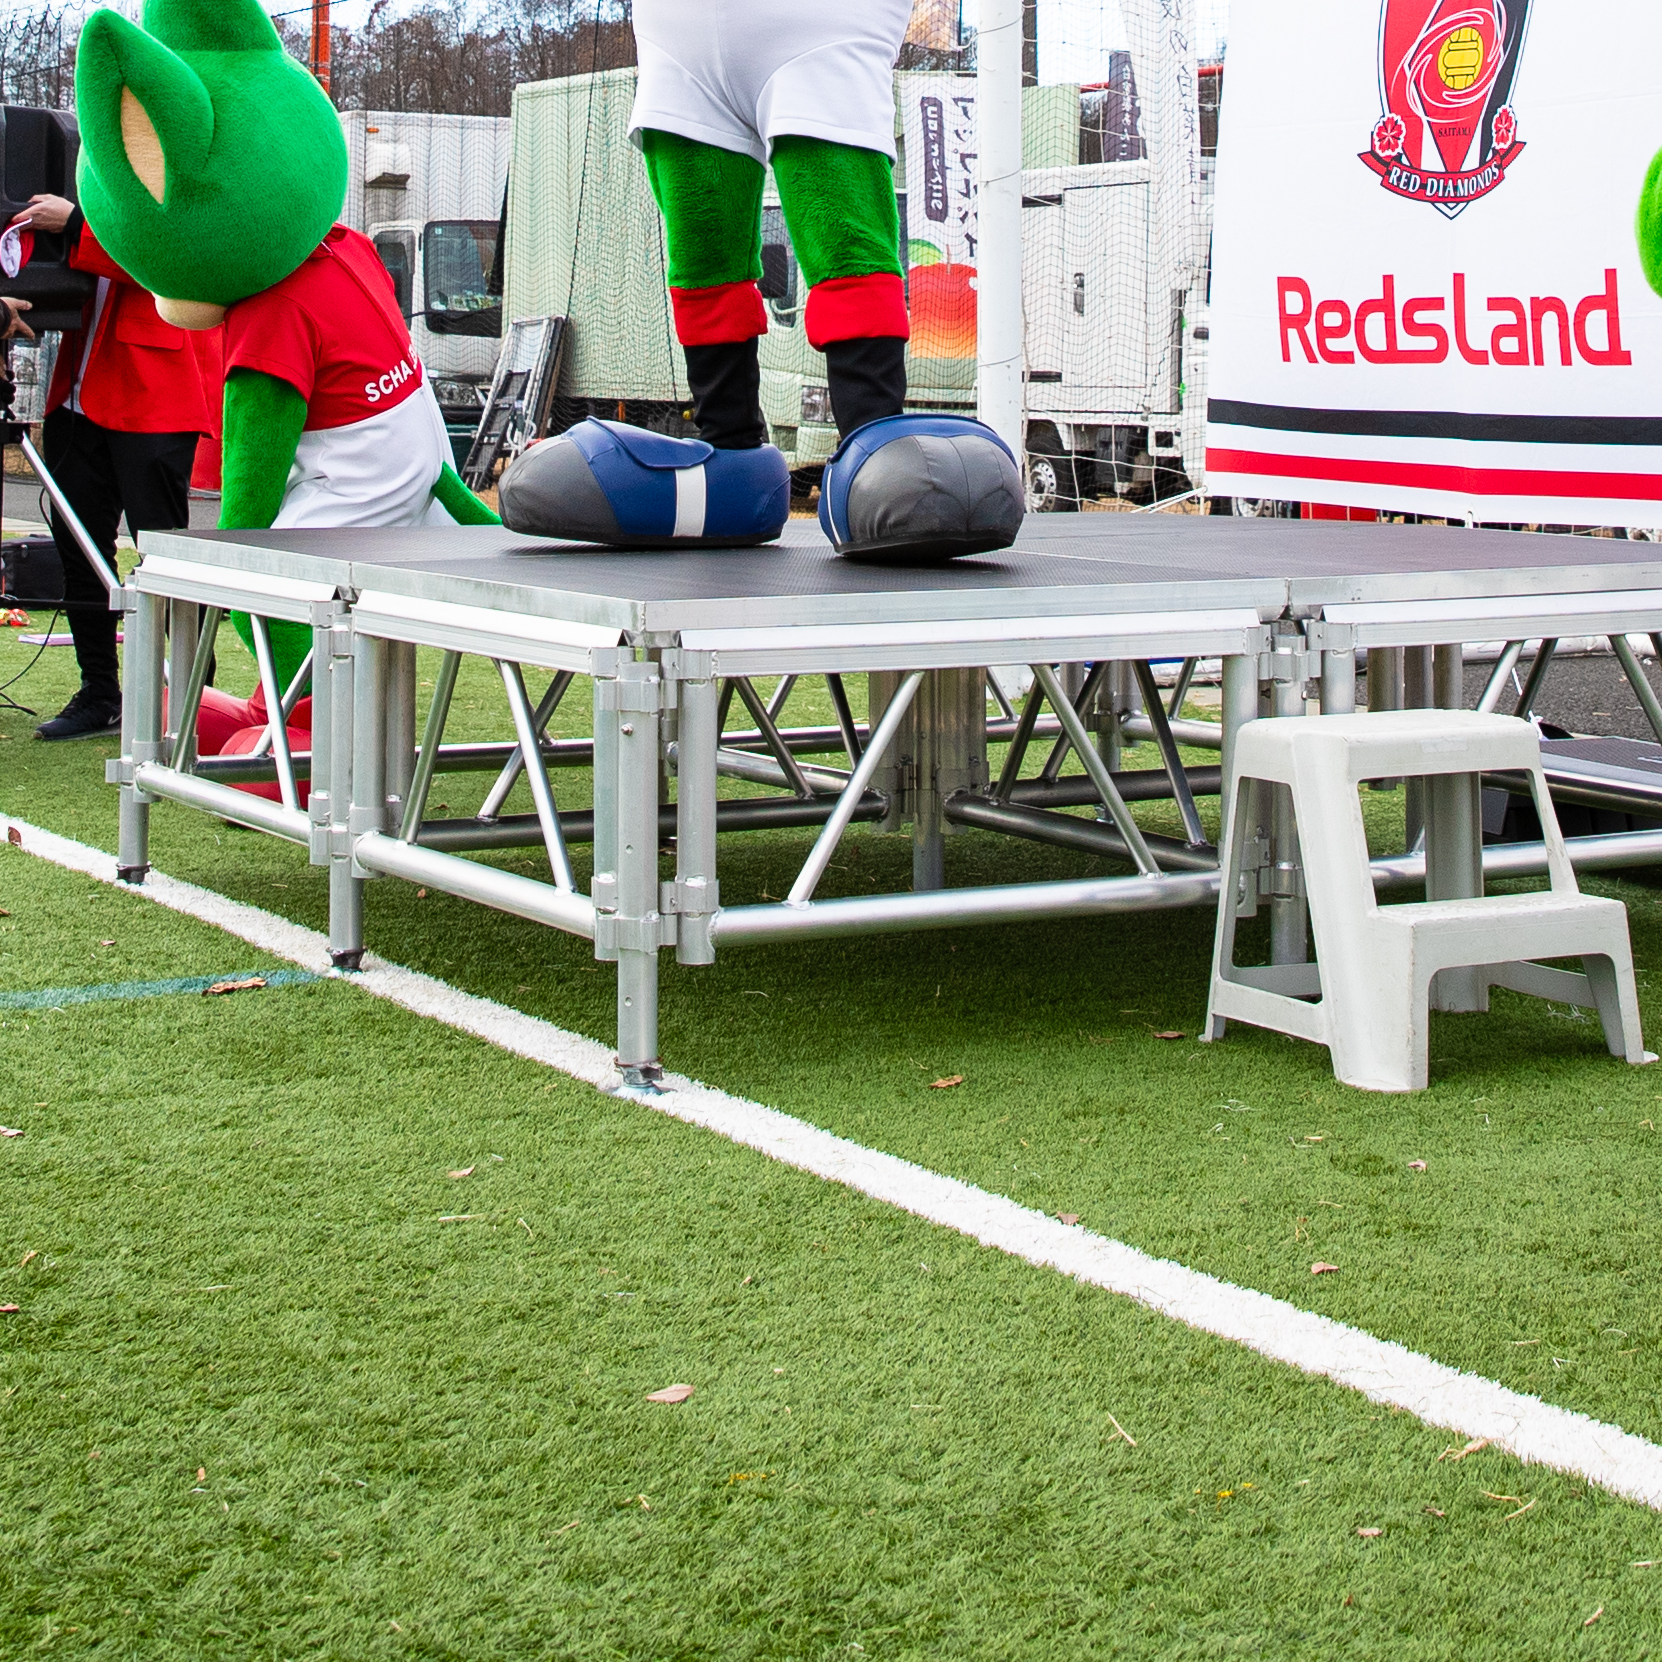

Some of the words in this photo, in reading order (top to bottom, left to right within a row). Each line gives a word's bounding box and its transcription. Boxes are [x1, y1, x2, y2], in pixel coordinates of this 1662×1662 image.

[1388, 166, 1421, 193] RED
[1425, 161, 1499, 197] DIAMONDS
[365, 344, 417, 402] SCHA
